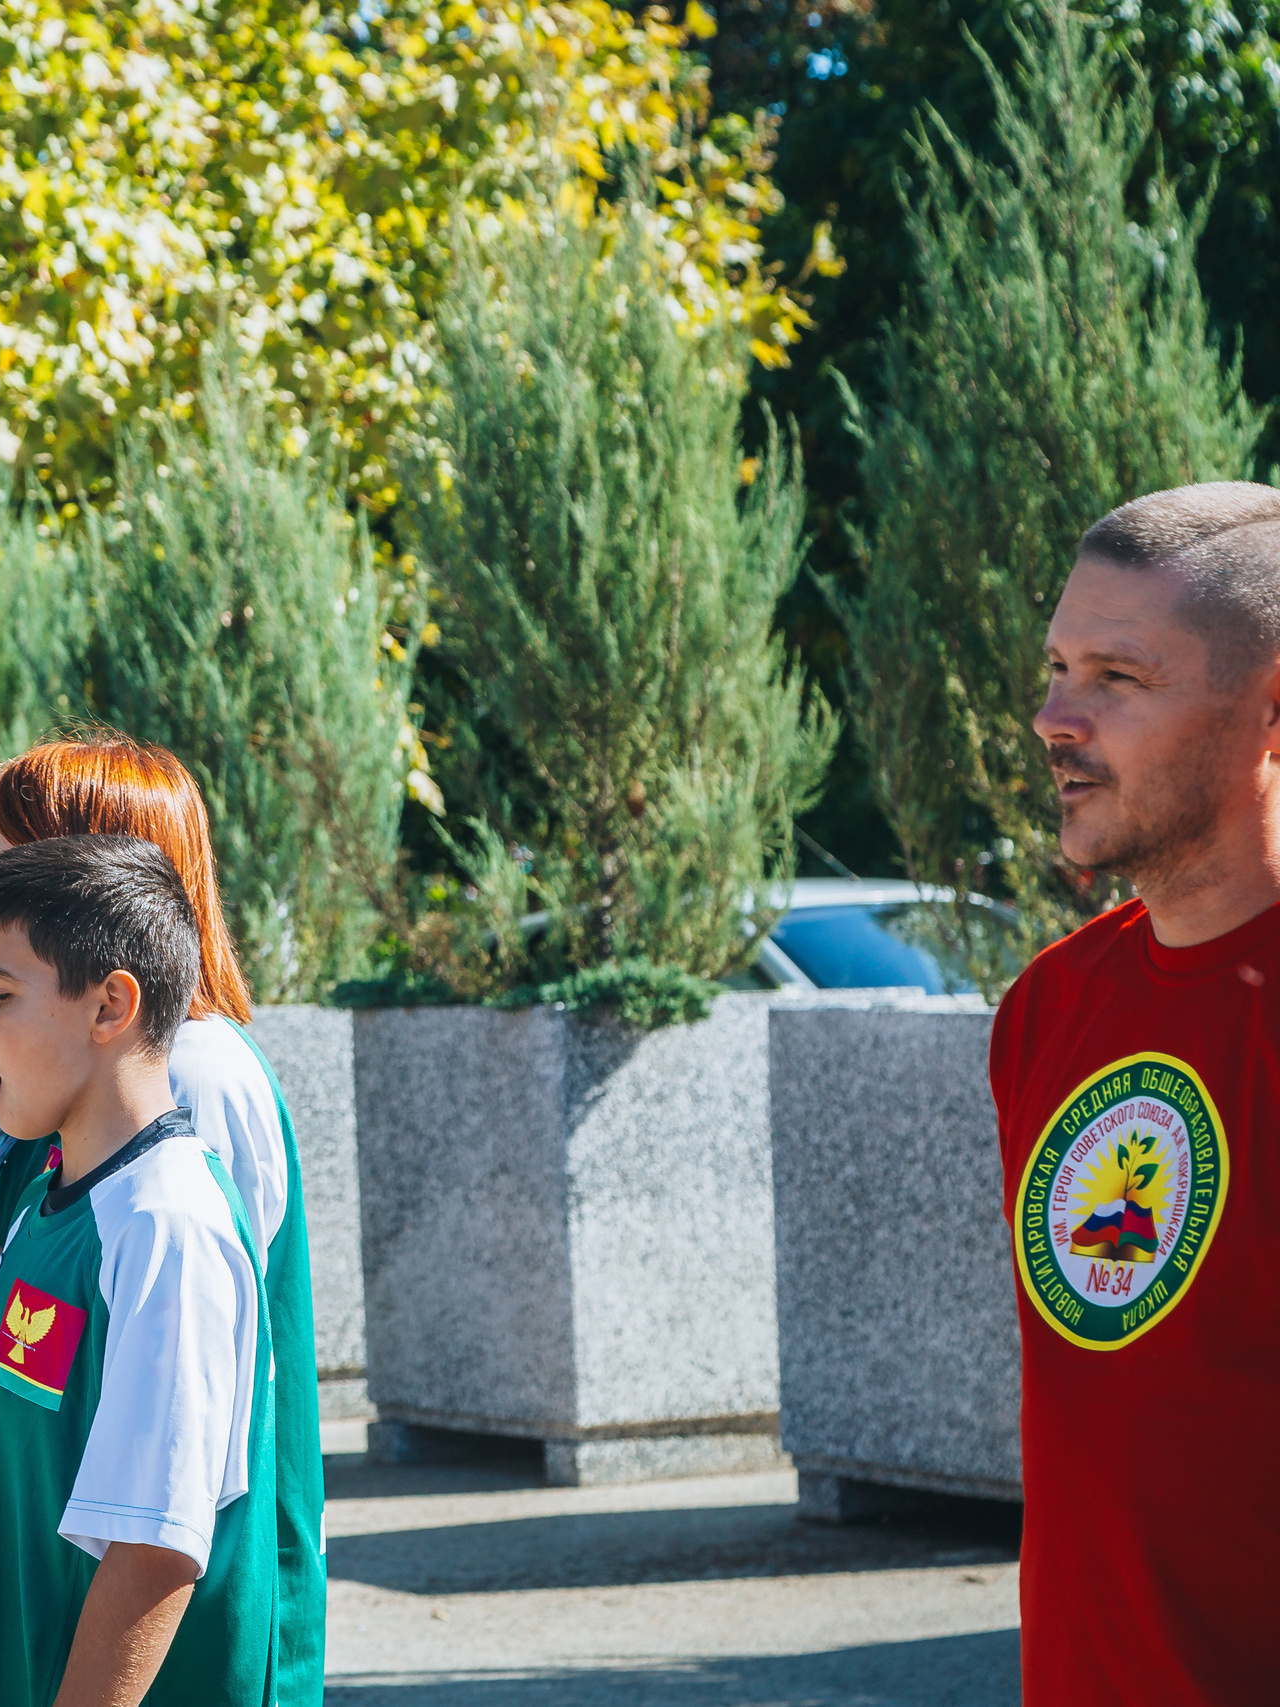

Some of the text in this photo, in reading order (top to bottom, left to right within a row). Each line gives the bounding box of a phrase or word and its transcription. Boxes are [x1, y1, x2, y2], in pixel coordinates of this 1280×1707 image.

[1026, 1067, 1216, 1332] НОВОТИТАРОВСКАЯ СРЕДНЯЯ ОБЩЕОБРАЗОВАТЕЛЬНАЯ ШКОЛА
[1052, 1164, 1077, 1212] ГЕРОЯ
[1070, 1103, 1136, 1163] СОВЕТСКОГО
[1137, 1101, 1174, 1131] СОЮЗА
[1157, 1151, 1189, 1257] ПОКРЫШКИНА
